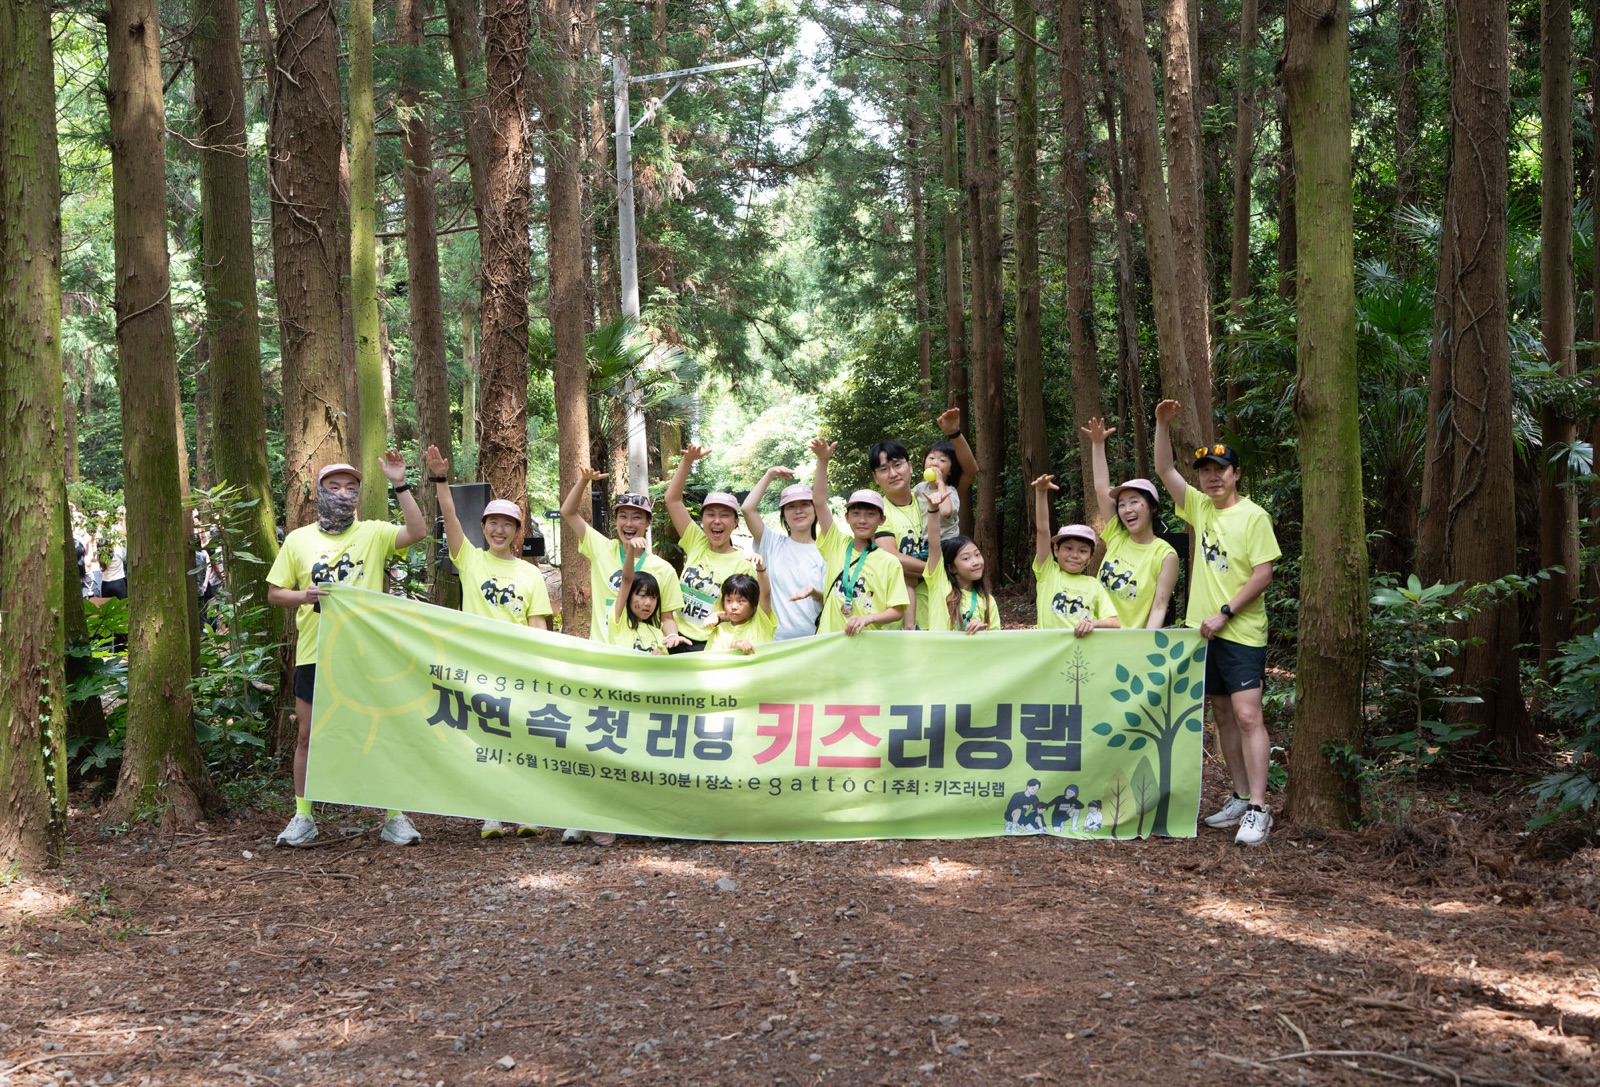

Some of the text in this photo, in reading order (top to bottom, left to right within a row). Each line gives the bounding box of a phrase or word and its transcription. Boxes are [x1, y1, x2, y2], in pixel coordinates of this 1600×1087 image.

[429, 664, 469, 684] 제1회
[608, 689, 641, 703] Kids
[646, 694, 706, 709] running
[711, 694, 738, 708] Lab
[426, 682, 1083, 771] 자연 속 첫 러닝 키즈러닝랩
[516, 752, 538, 769] 6월
[542, 757, 596, 778] 13일(토)
[600, 766, 627, 782] 오전
[631, 770, 654, 785] 8시
[659, 772, 691, 788] 30분
[934, 780, 1005, 797] 키즈러닝랩
